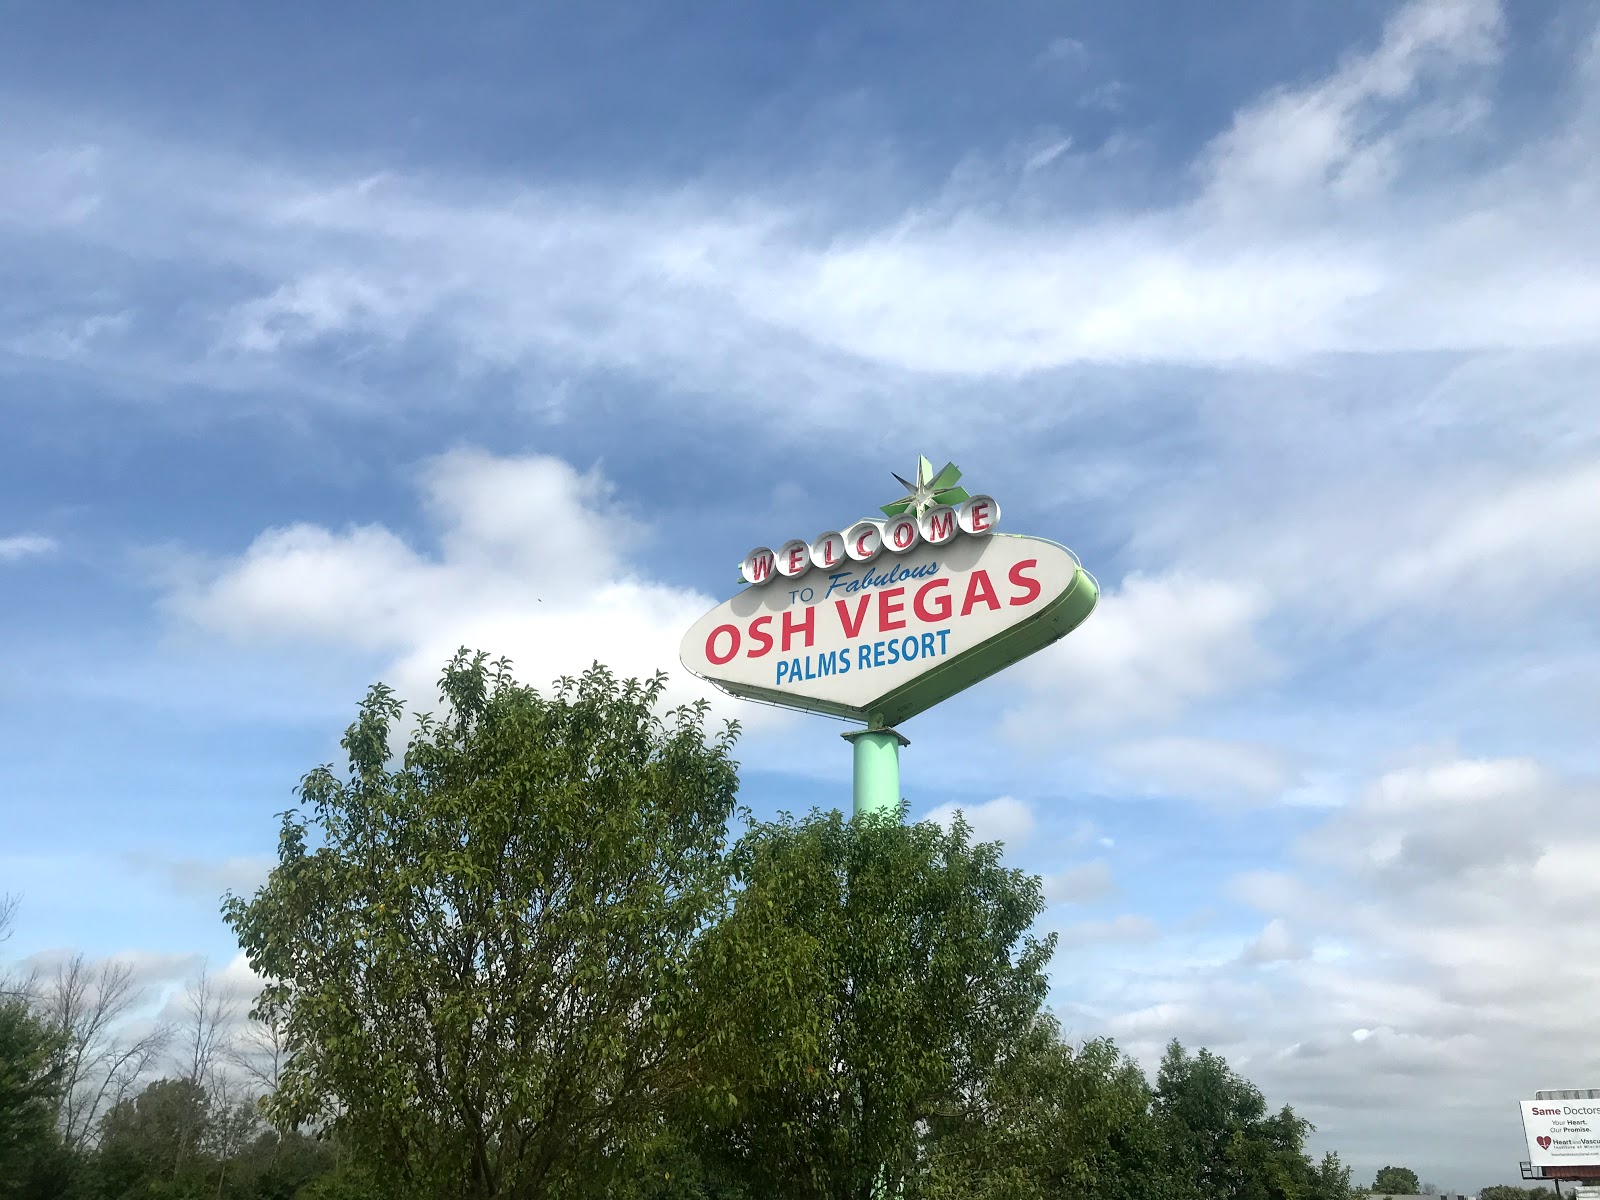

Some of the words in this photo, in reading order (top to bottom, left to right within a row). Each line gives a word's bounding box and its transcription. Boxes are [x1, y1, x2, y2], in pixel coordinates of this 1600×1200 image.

[752, 501, 990, 581] WELCOME
[789, 587, 814, 604] TO
[824, 561, 940, 599] Fabulous
[704, 605, 815, 665] OSH
[834, 558, 1042, 640] VEGAS
[776, 648, 851, 685] PALMS
[858, 629, 951, 670] RESORT
[1532, 1107, 1561, 1116] Same
